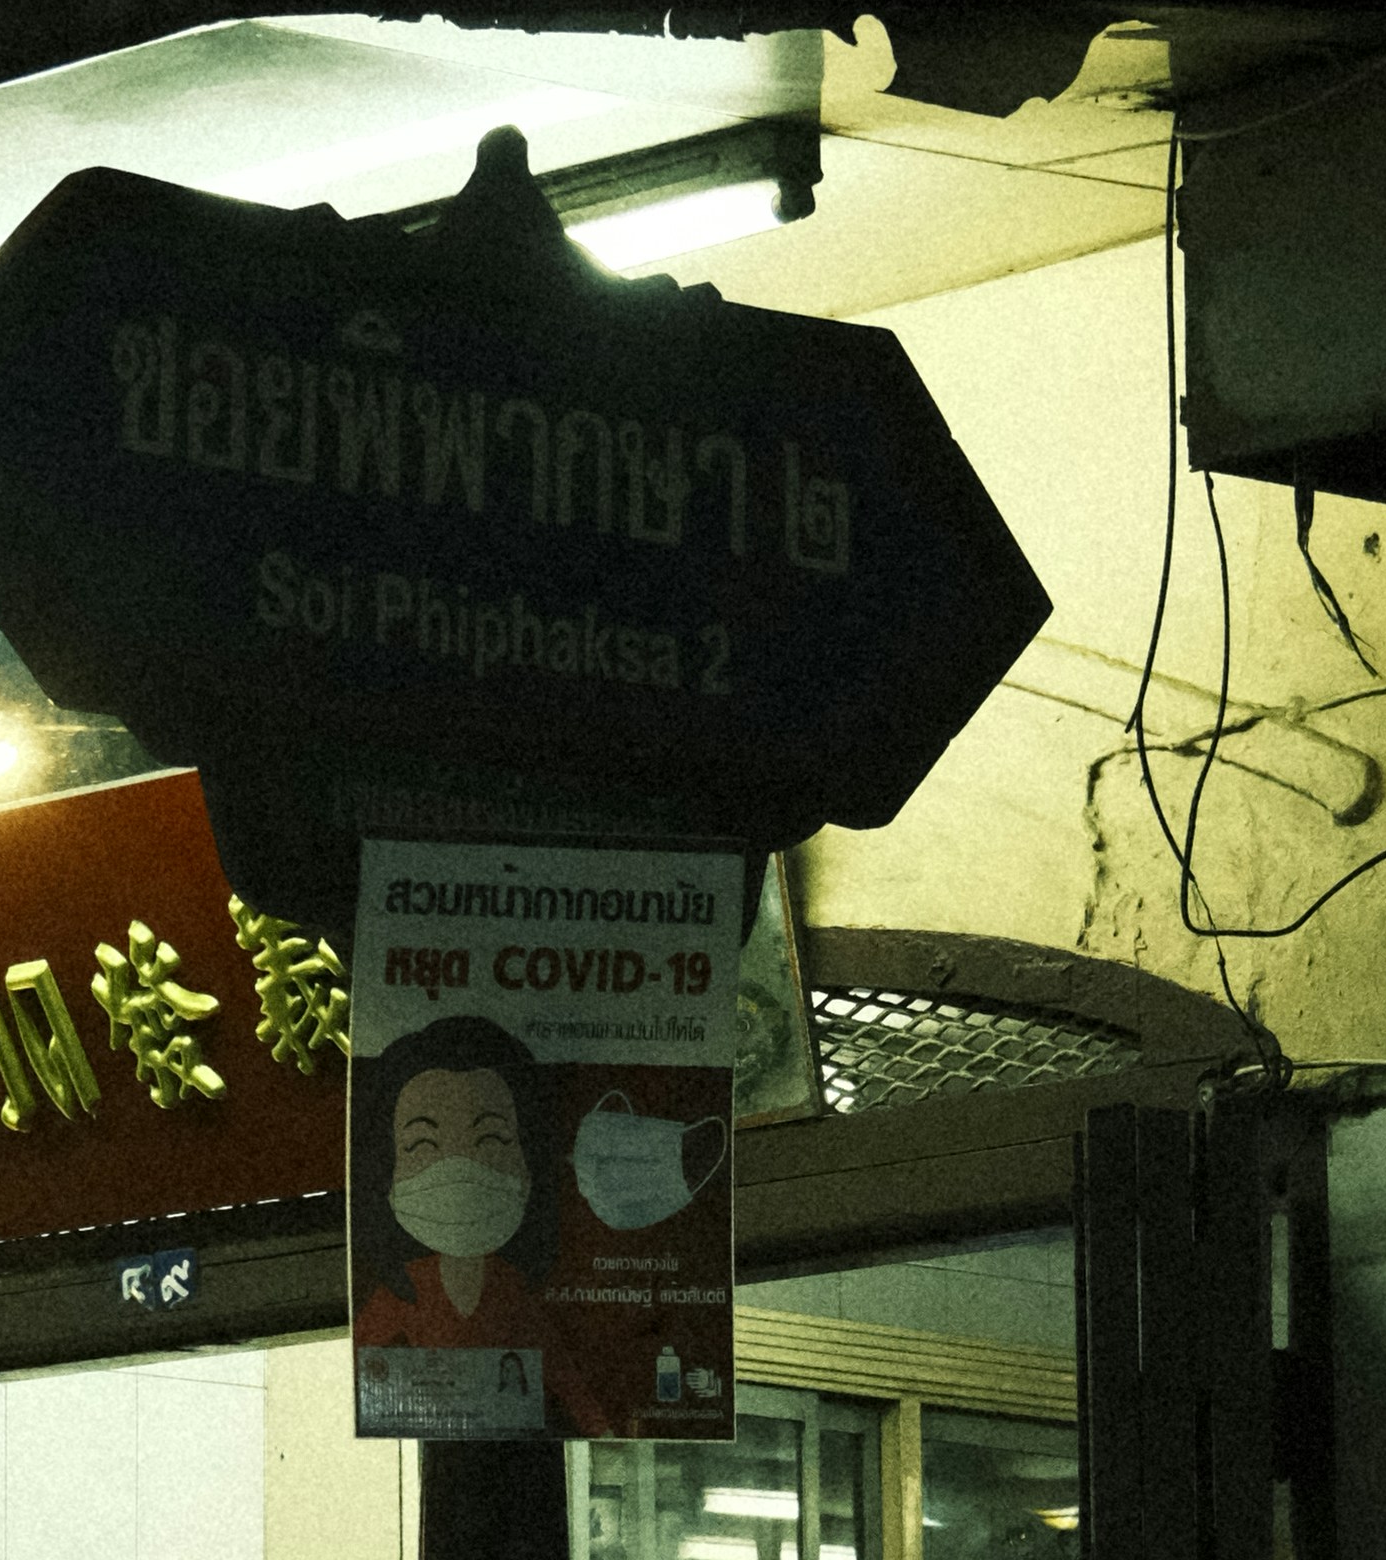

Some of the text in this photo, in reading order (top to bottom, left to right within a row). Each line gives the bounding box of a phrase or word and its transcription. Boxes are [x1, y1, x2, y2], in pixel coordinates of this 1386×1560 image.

[257, 556, 733, 696] Soi Phiphaksa 2
[384, 945, 714, 1001] หยุด COVID-19
